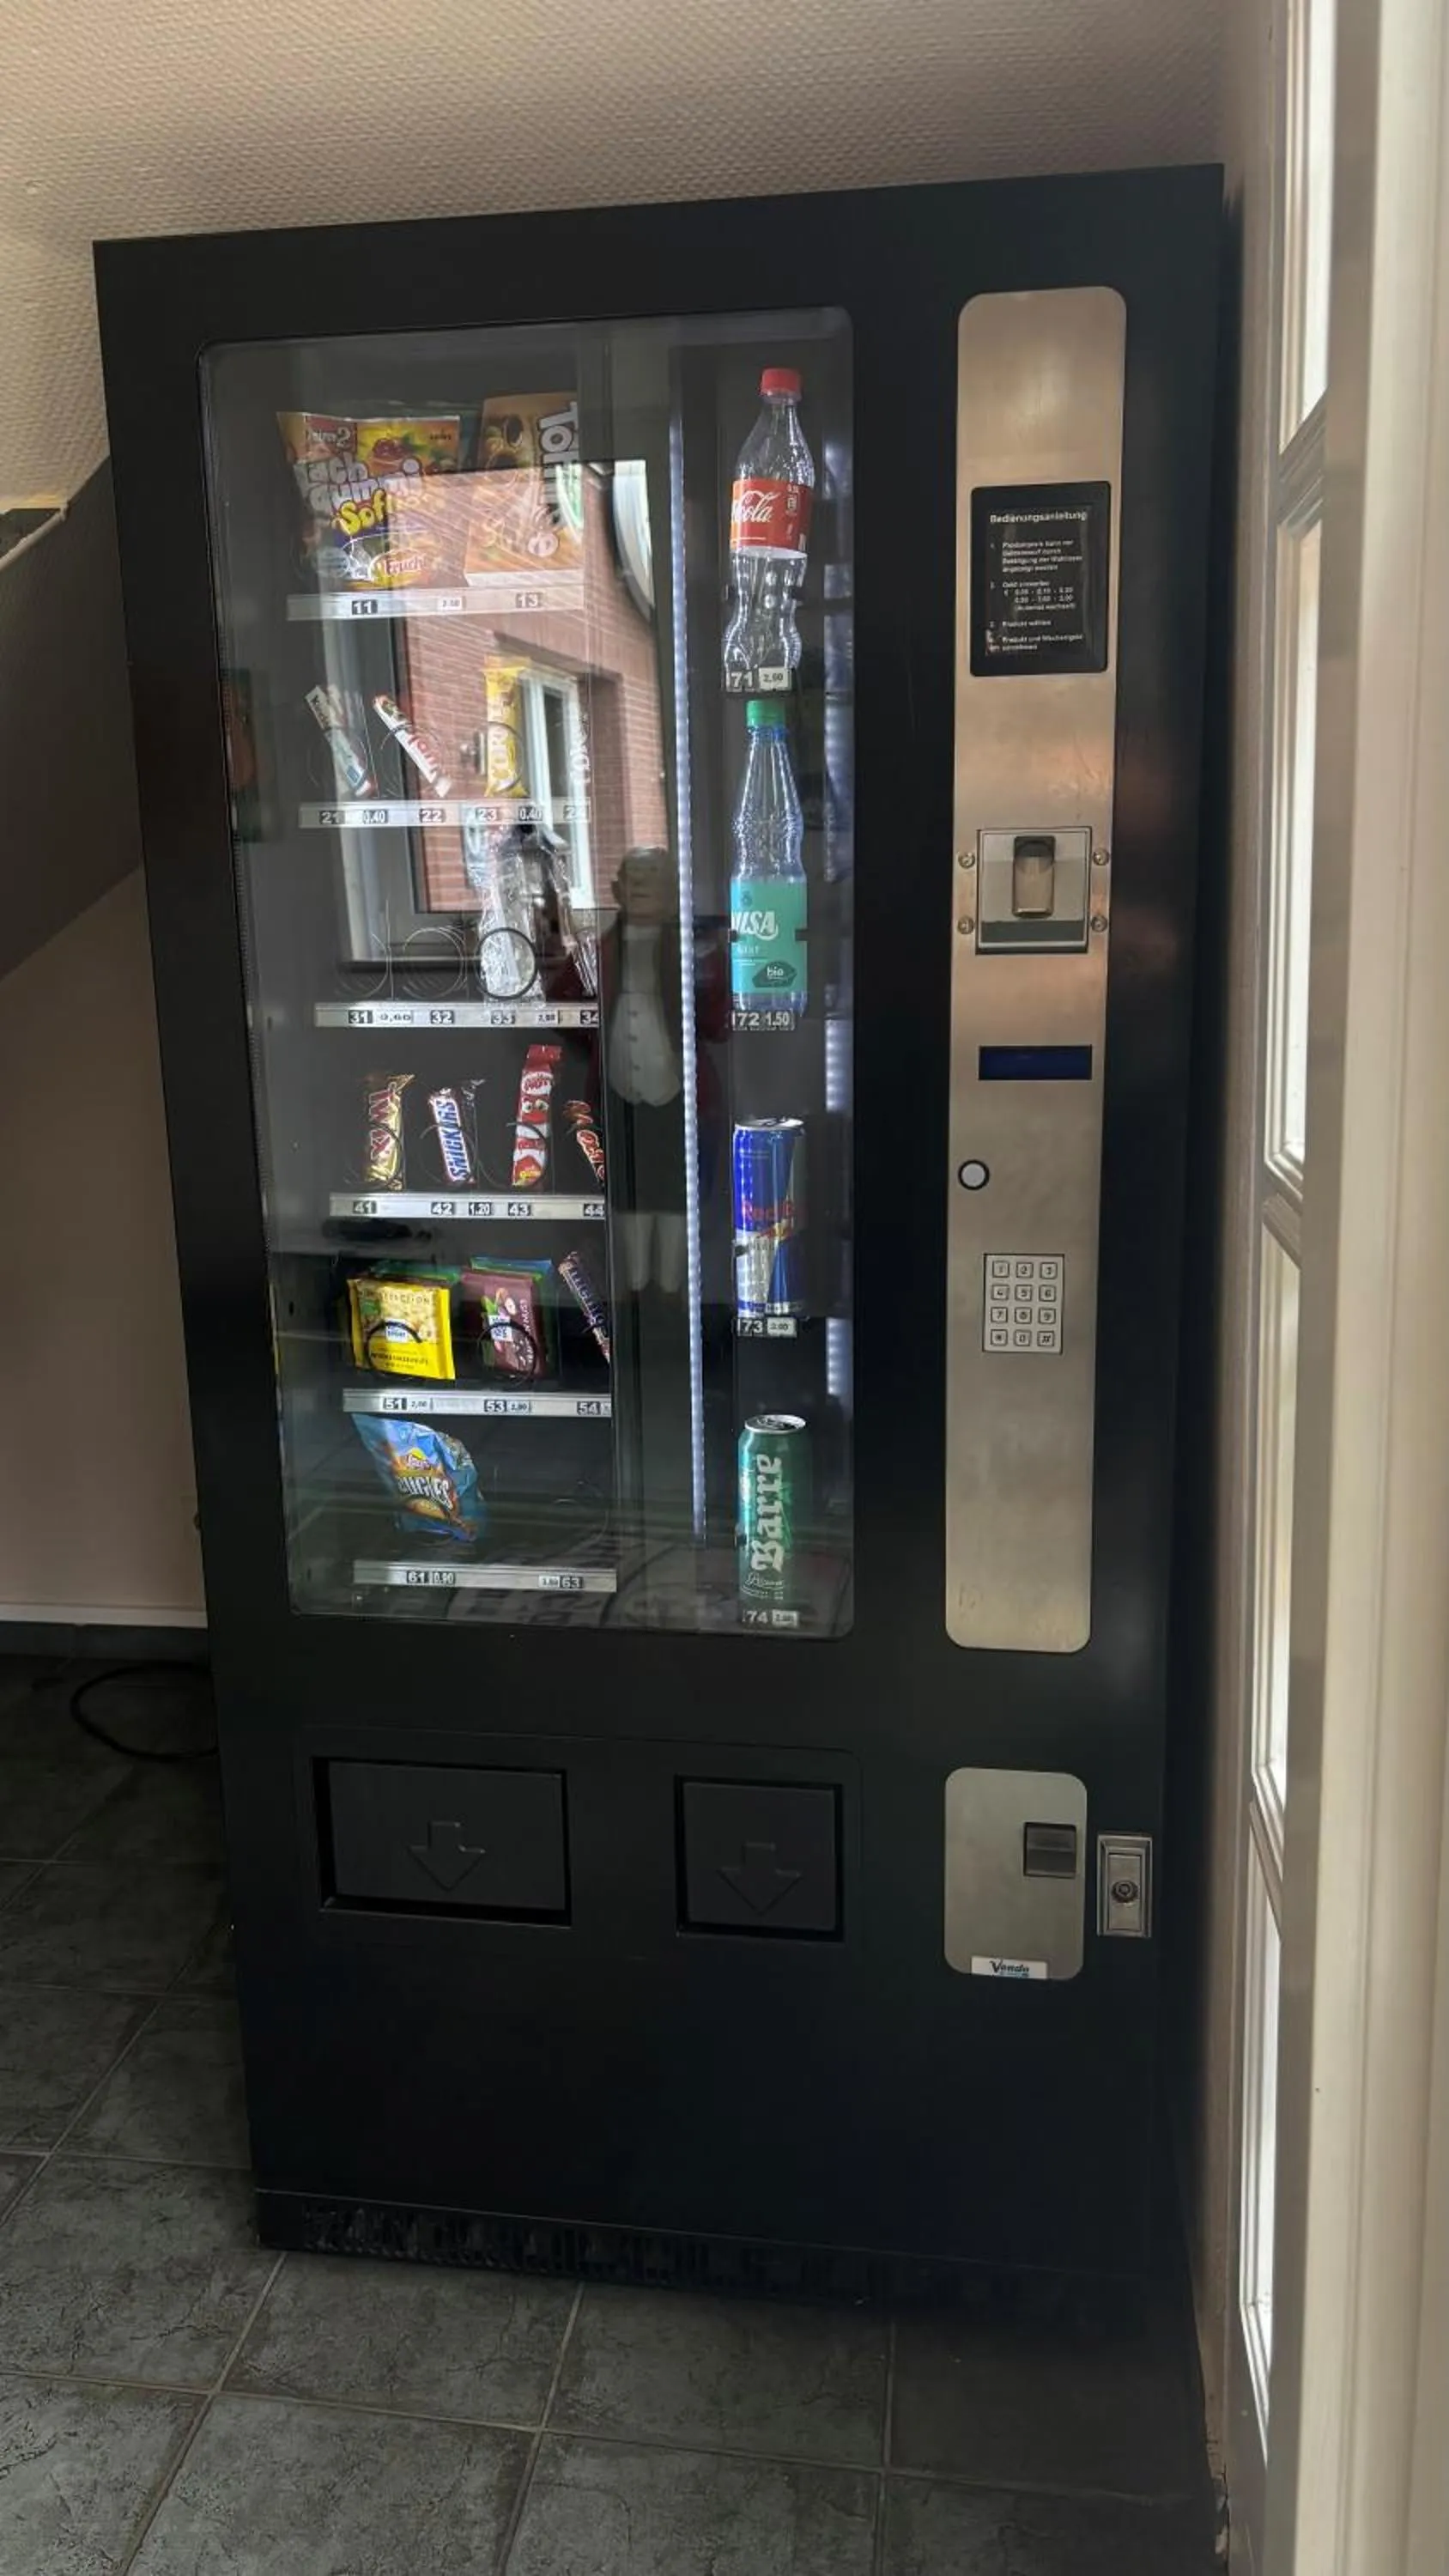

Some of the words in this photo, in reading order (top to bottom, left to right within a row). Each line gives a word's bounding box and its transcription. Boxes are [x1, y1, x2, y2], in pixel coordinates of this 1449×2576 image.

[353, 601, 373, 614] 11
[518, 594, 539, 608] 13
[731, 671, 753, 688] 71
[321, 811, 340, 824] 21
[363, 810, 385, 823] 0.40
[421, 809, 443, 823] 22
[478, 808, 497, 822] 23
[767, 965, 784, 976] bio
[350, 1011, 368, 1024] 31
[432, 1011, 452, 1024] 32
[492, 1012, 513, 1024] 33
[737, 1012, 760, 1026] 72
[764, 1012, 791, 1026] 1.50
[355, 1201, 373, 1214] 41
[432, 1202, 452, 1216] 42
[509, 1202, 530, 1217] 43
[742, 1319, 763, 1334] 73
[385, 1398, 401, 1410] 51
[487, 1400, 506, 1413] 53
[579, 1402, 599, 1415] 54
[751, 1454, 784, 1573] Barre
[408, 1571, 427, 1583] 61
[562, 1577, 581, 1588] 63
[746, 1610, 768, 1625] 74
